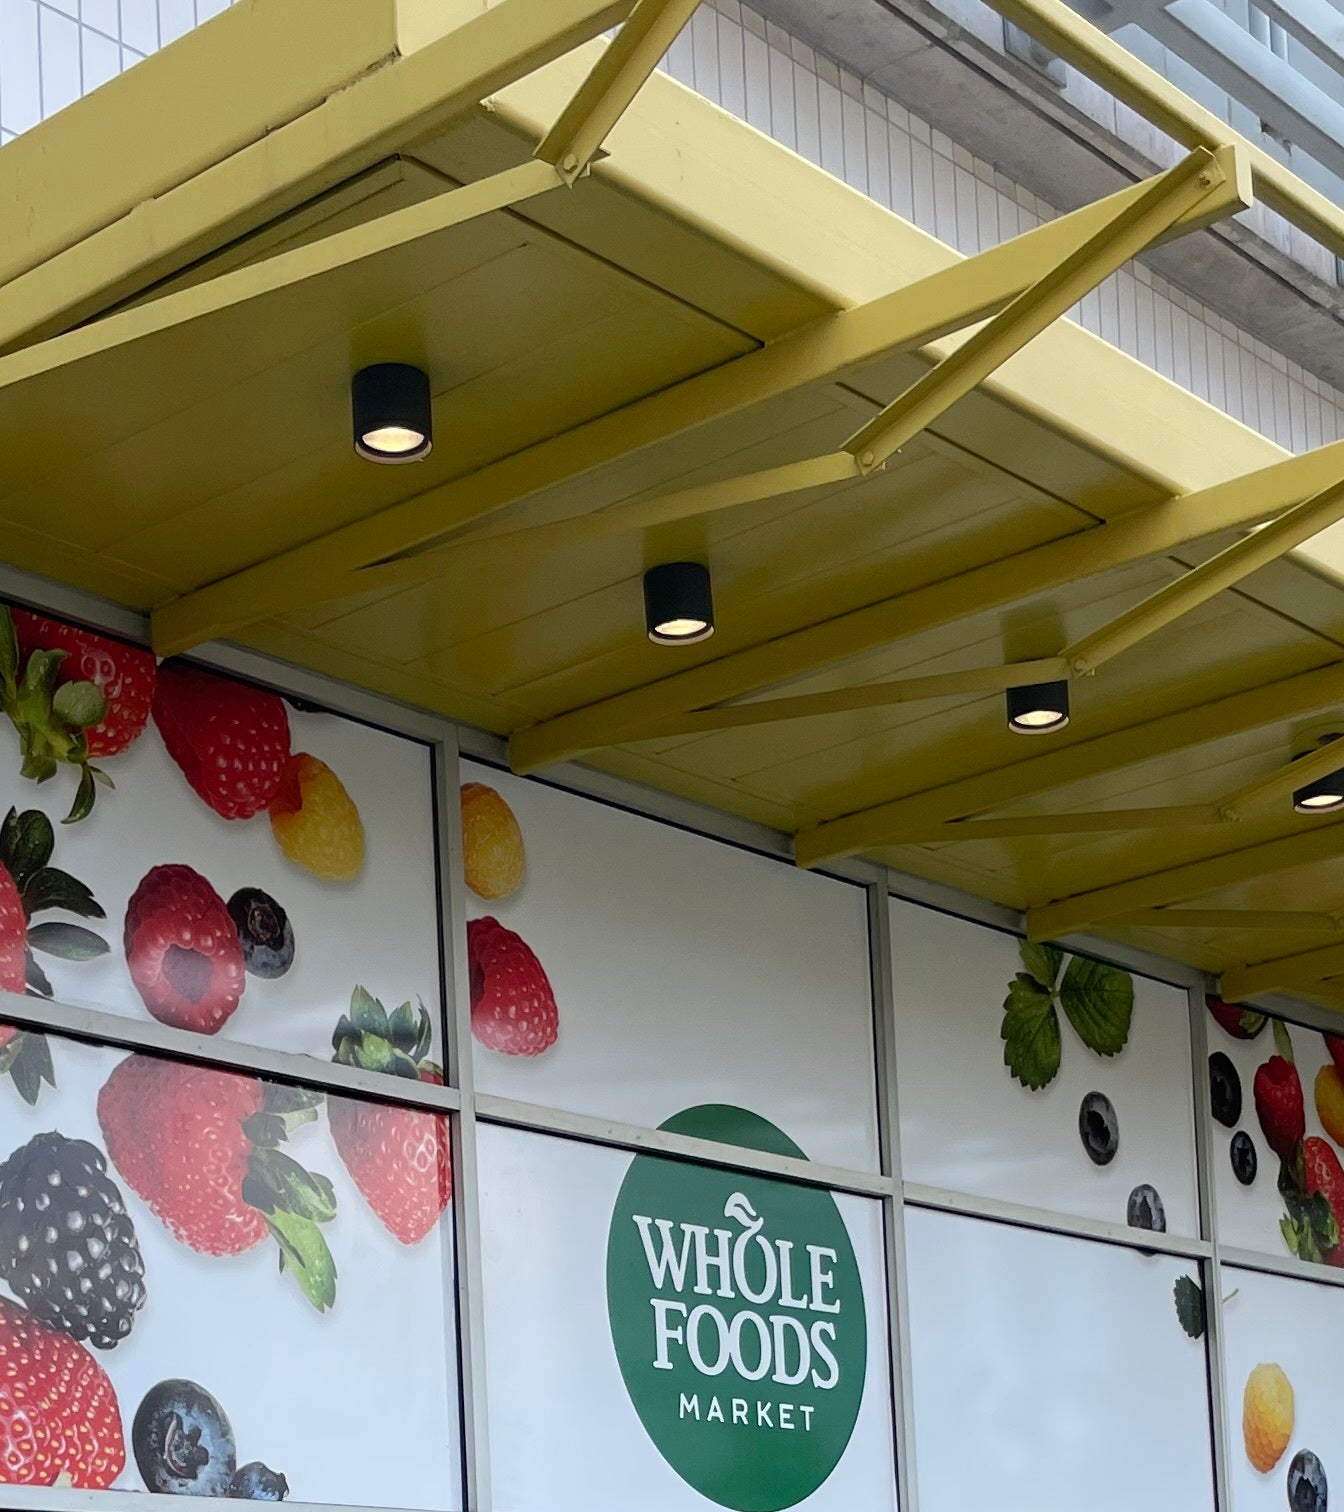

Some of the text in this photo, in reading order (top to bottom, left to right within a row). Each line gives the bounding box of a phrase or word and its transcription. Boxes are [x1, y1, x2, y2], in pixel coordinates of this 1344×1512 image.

[632, 1213, 841, 1314] WHOLE
[650, 1298, 840, 1390] FOODS
[679, 1392, 815, 1431] MARKET
